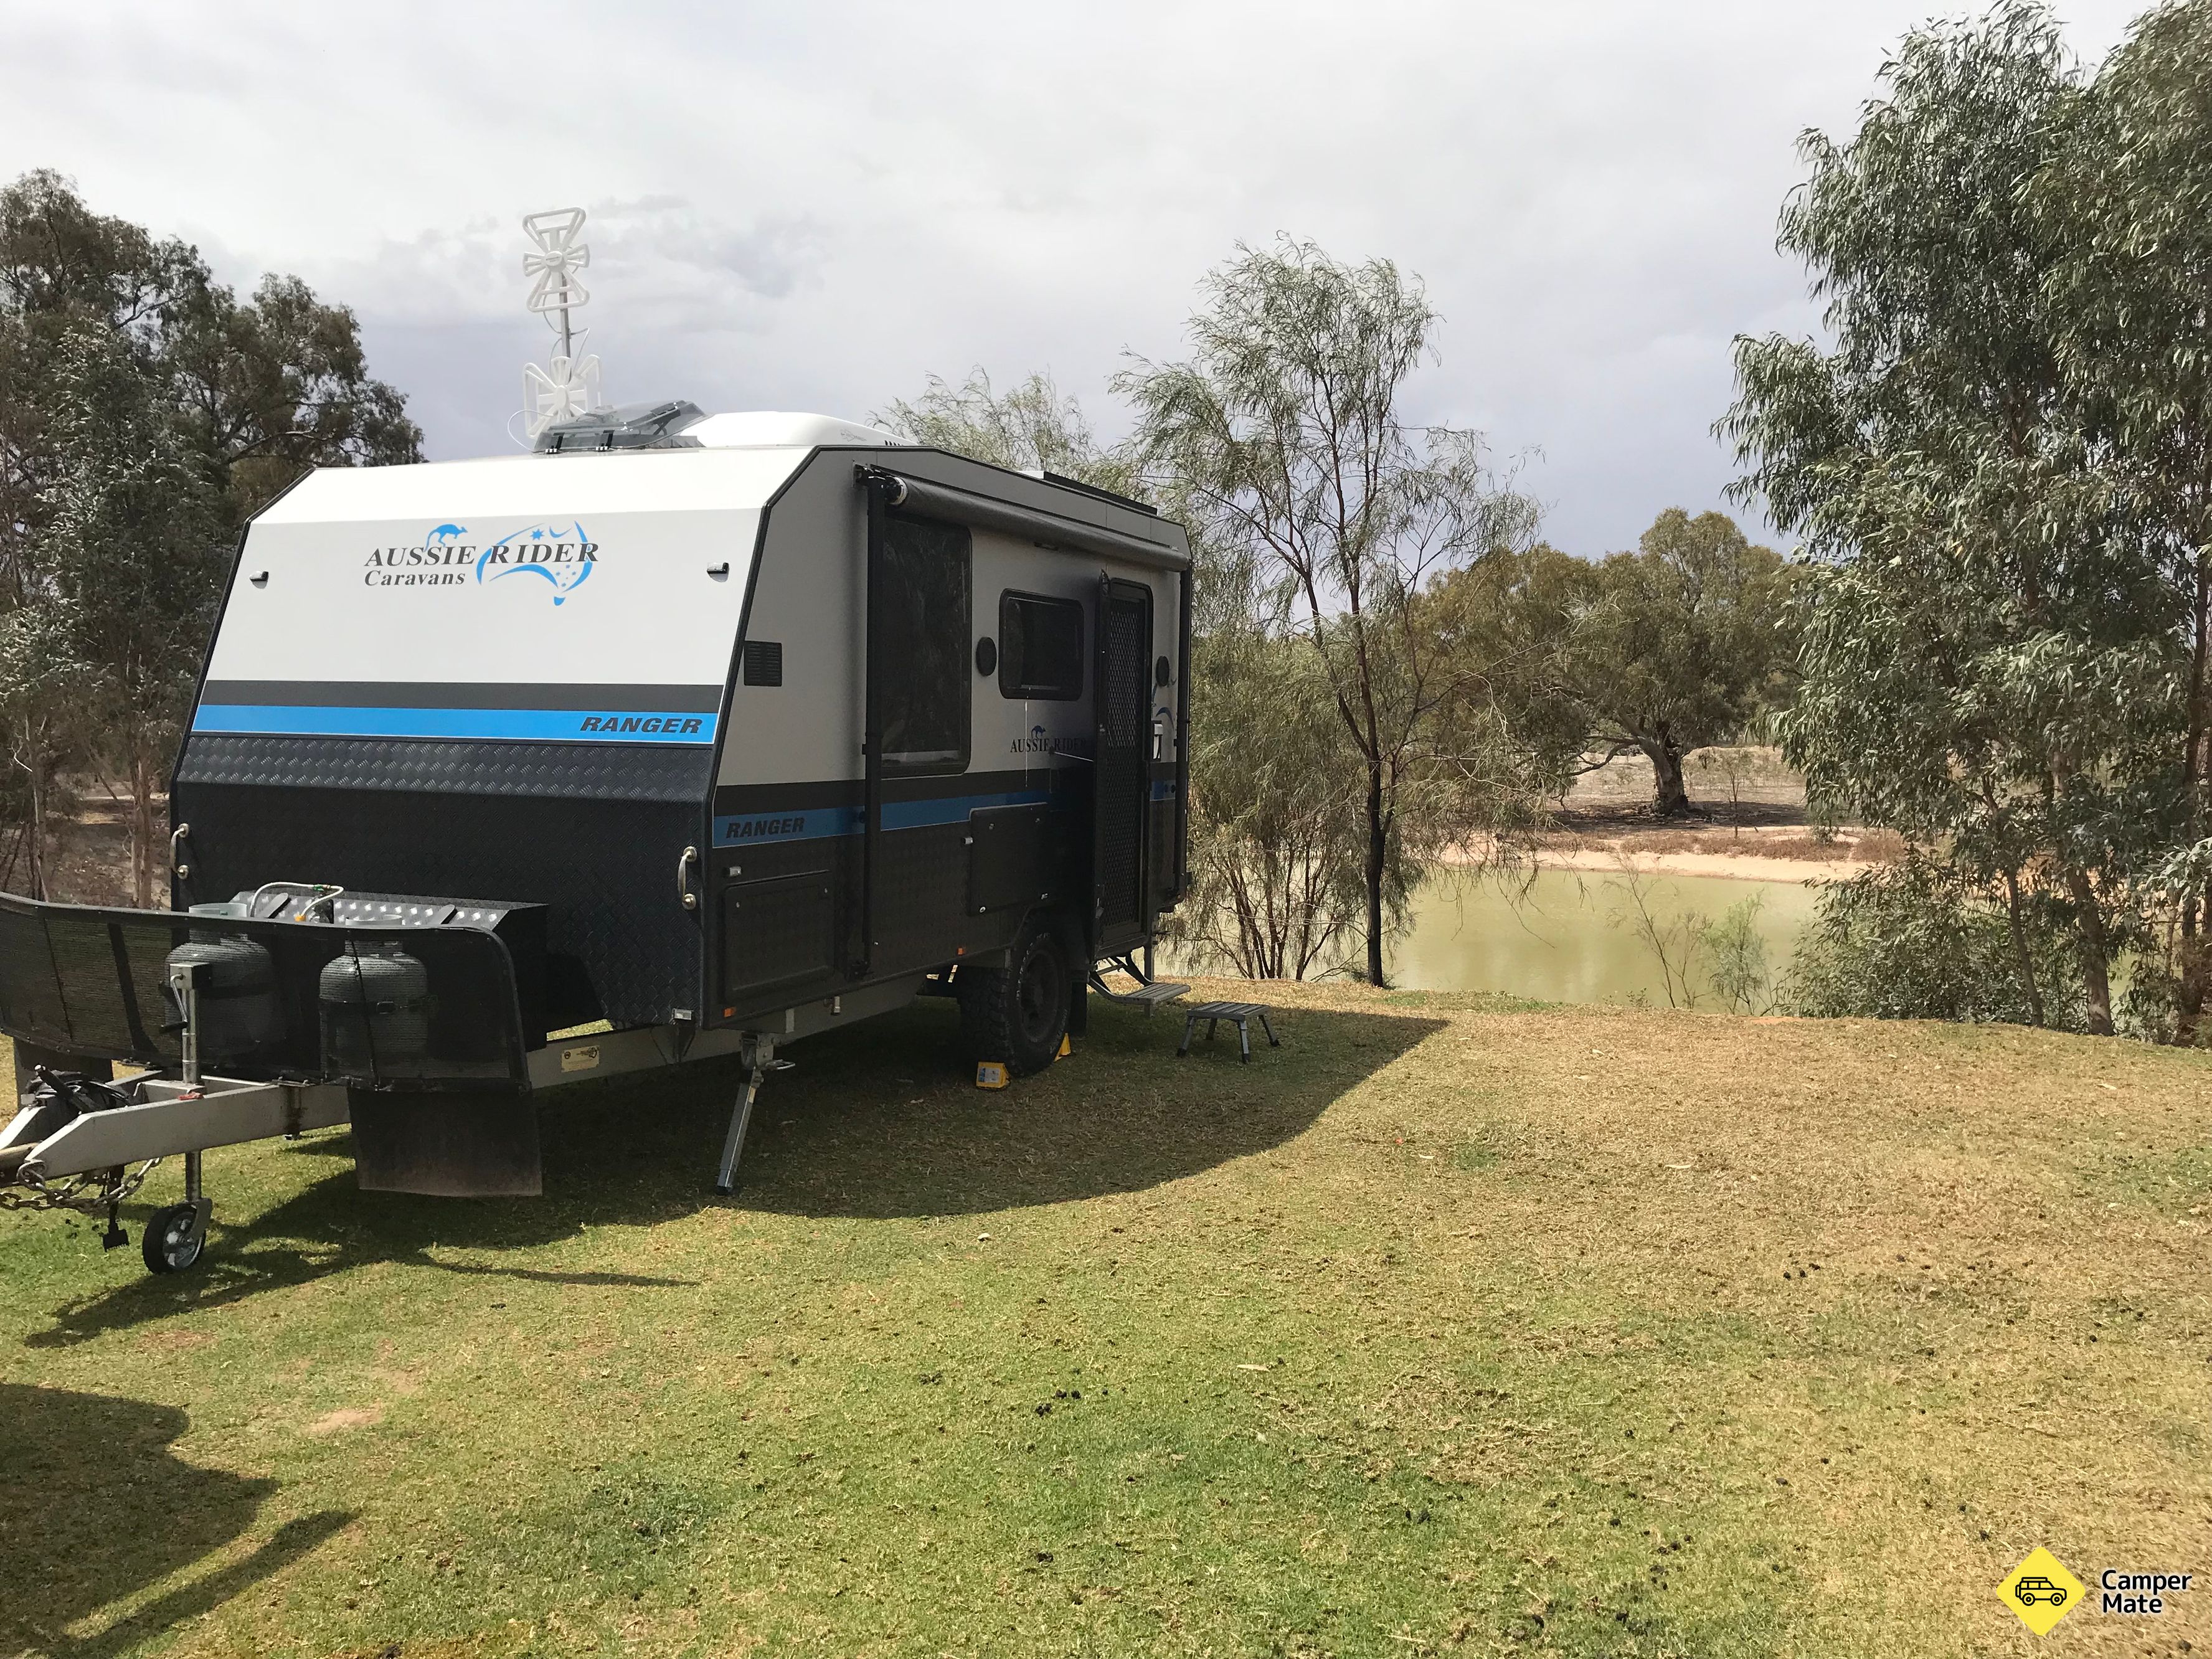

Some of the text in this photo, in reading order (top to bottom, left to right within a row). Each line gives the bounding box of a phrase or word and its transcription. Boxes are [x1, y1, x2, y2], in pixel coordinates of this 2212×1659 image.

[364, 542, 598, 567] AUSSIE RIDER
[364, 569, 466, 587] Caravans
[579, 716, 704, 734] RANGER
[1009, 736, 1087, 753] AUSSIE RIDER
[726, 817, 805, 839] RANGER
